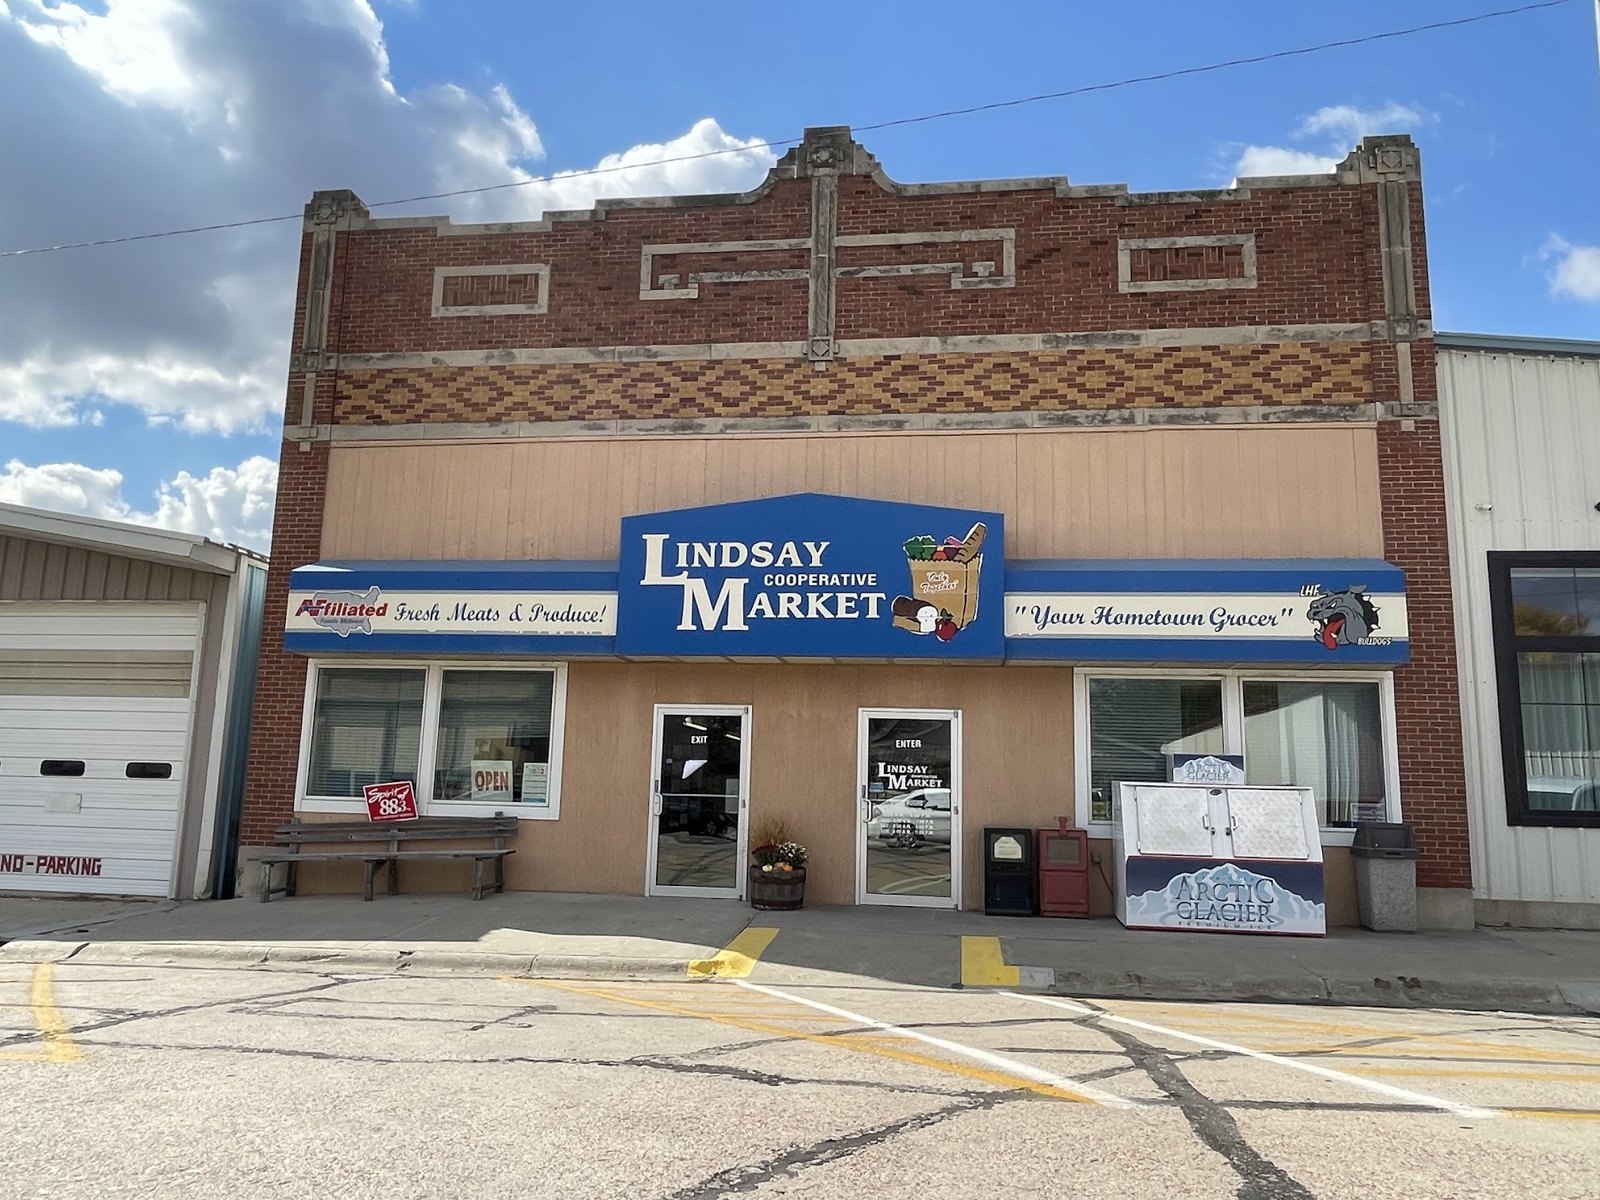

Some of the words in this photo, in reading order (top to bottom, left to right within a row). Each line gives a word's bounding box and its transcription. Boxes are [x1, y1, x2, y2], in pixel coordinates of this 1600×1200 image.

[640, 533, 830, 586] LINDSAY
[764, 573, 877, 586] COOPERATIVE
[1299, 584, 1321, 597] LHF
[676, 578, 886, 631] MARKET
[394, 603, 440, 621] Fresh
[447, 603, 500, 621] Meats
[509, 603, 523, 621] &
[529, 603, 607, 623] Produce!
[1091, 606, 1205, 626] Hometown
[1357, 637, 1392, 646] BULLDOGS
[691, 736, 708, 744] EXIT
[896, 739, 922, 748] ENTER
[878, 762, 928, 777] LINDSAY
[1187, 761, 1230, 774] ARCTIC
[475, 770, 509, 791] OPEN
[887, 774, 943, 790] MARKET
[1187, 772, 1229, 781] GLACIER
[368, 785, 409, 803] Spirit
[380, 798, 407, 815] 88.3
[1175, 875, 1275, 903] ARCTIC
[1176, 902, 1274, 923] GLACIER
